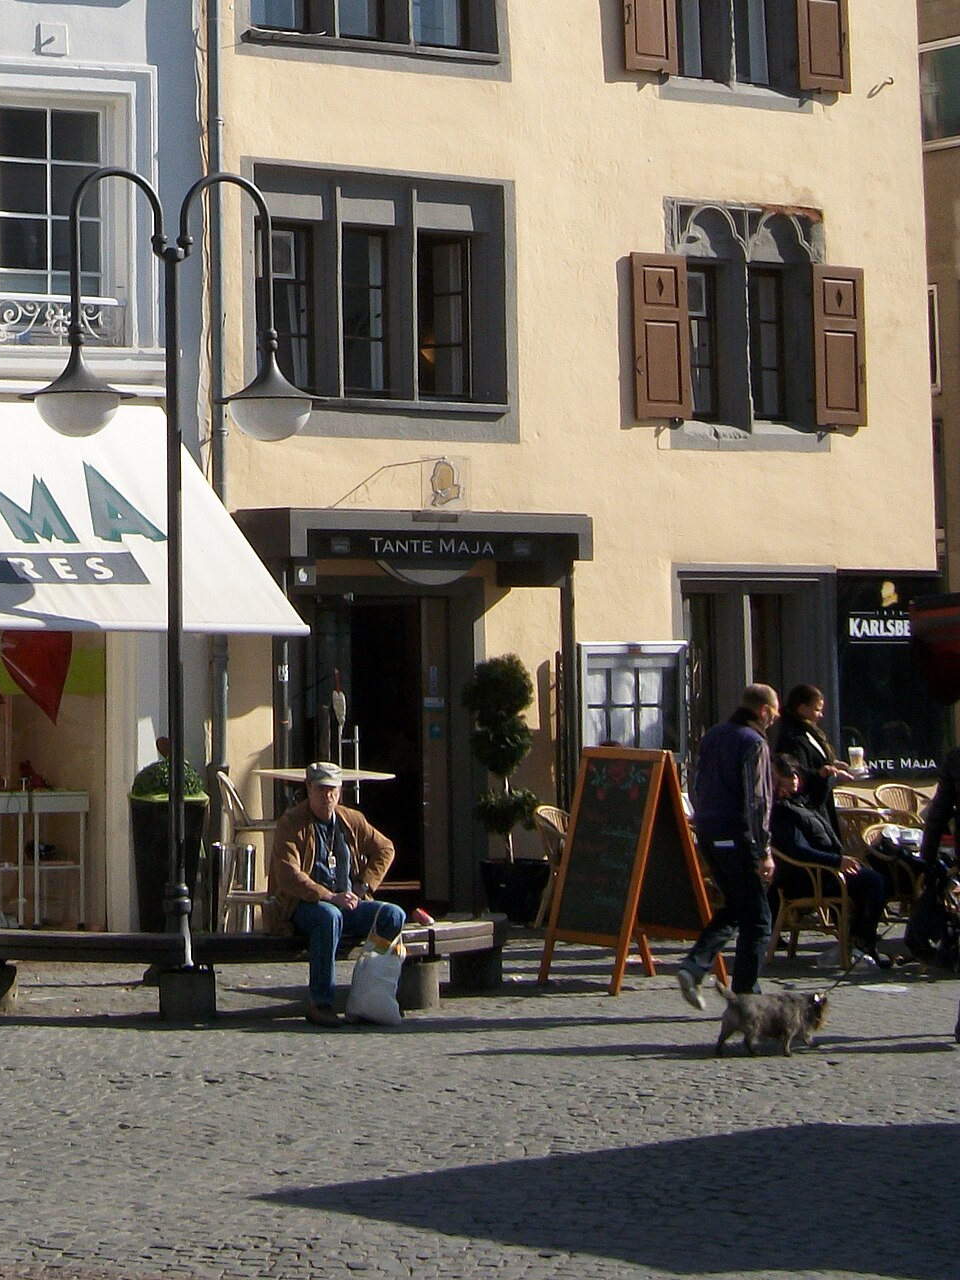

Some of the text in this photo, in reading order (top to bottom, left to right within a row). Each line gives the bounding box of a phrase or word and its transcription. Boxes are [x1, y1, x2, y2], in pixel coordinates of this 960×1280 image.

[370, 537, 434, 554] TANTE
[440, 538, 495, 555] MAJA
[849, 617, 911, 637] KARLSBE
[862, 758, 937, 770] ANTE MAJA
